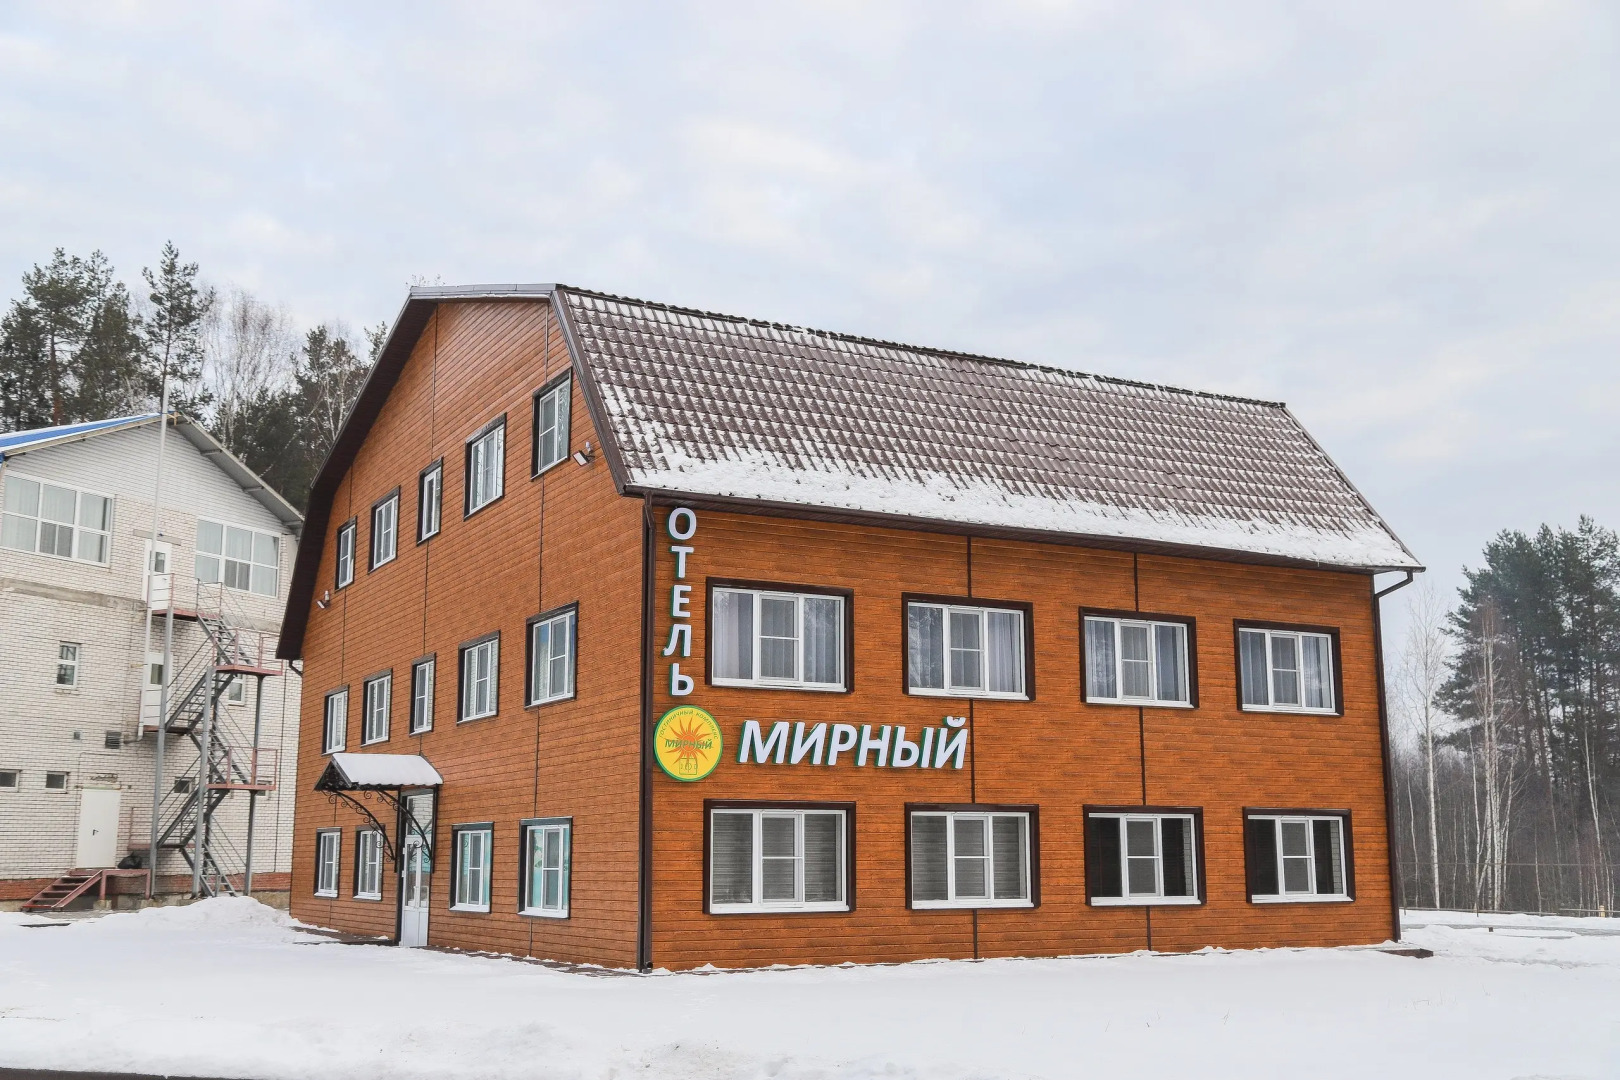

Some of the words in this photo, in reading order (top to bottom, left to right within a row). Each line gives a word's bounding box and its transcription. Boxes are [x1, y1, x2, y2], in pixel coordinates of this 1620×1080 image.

[662, 507, 697, 696] ОТЕЛЬ
[664, 738, 713, 750] МИРНЫЙ
[695, 712, 719, 740] КОМПЛЕКС
[736, 716, 969, 769] МИРНЫЙ
